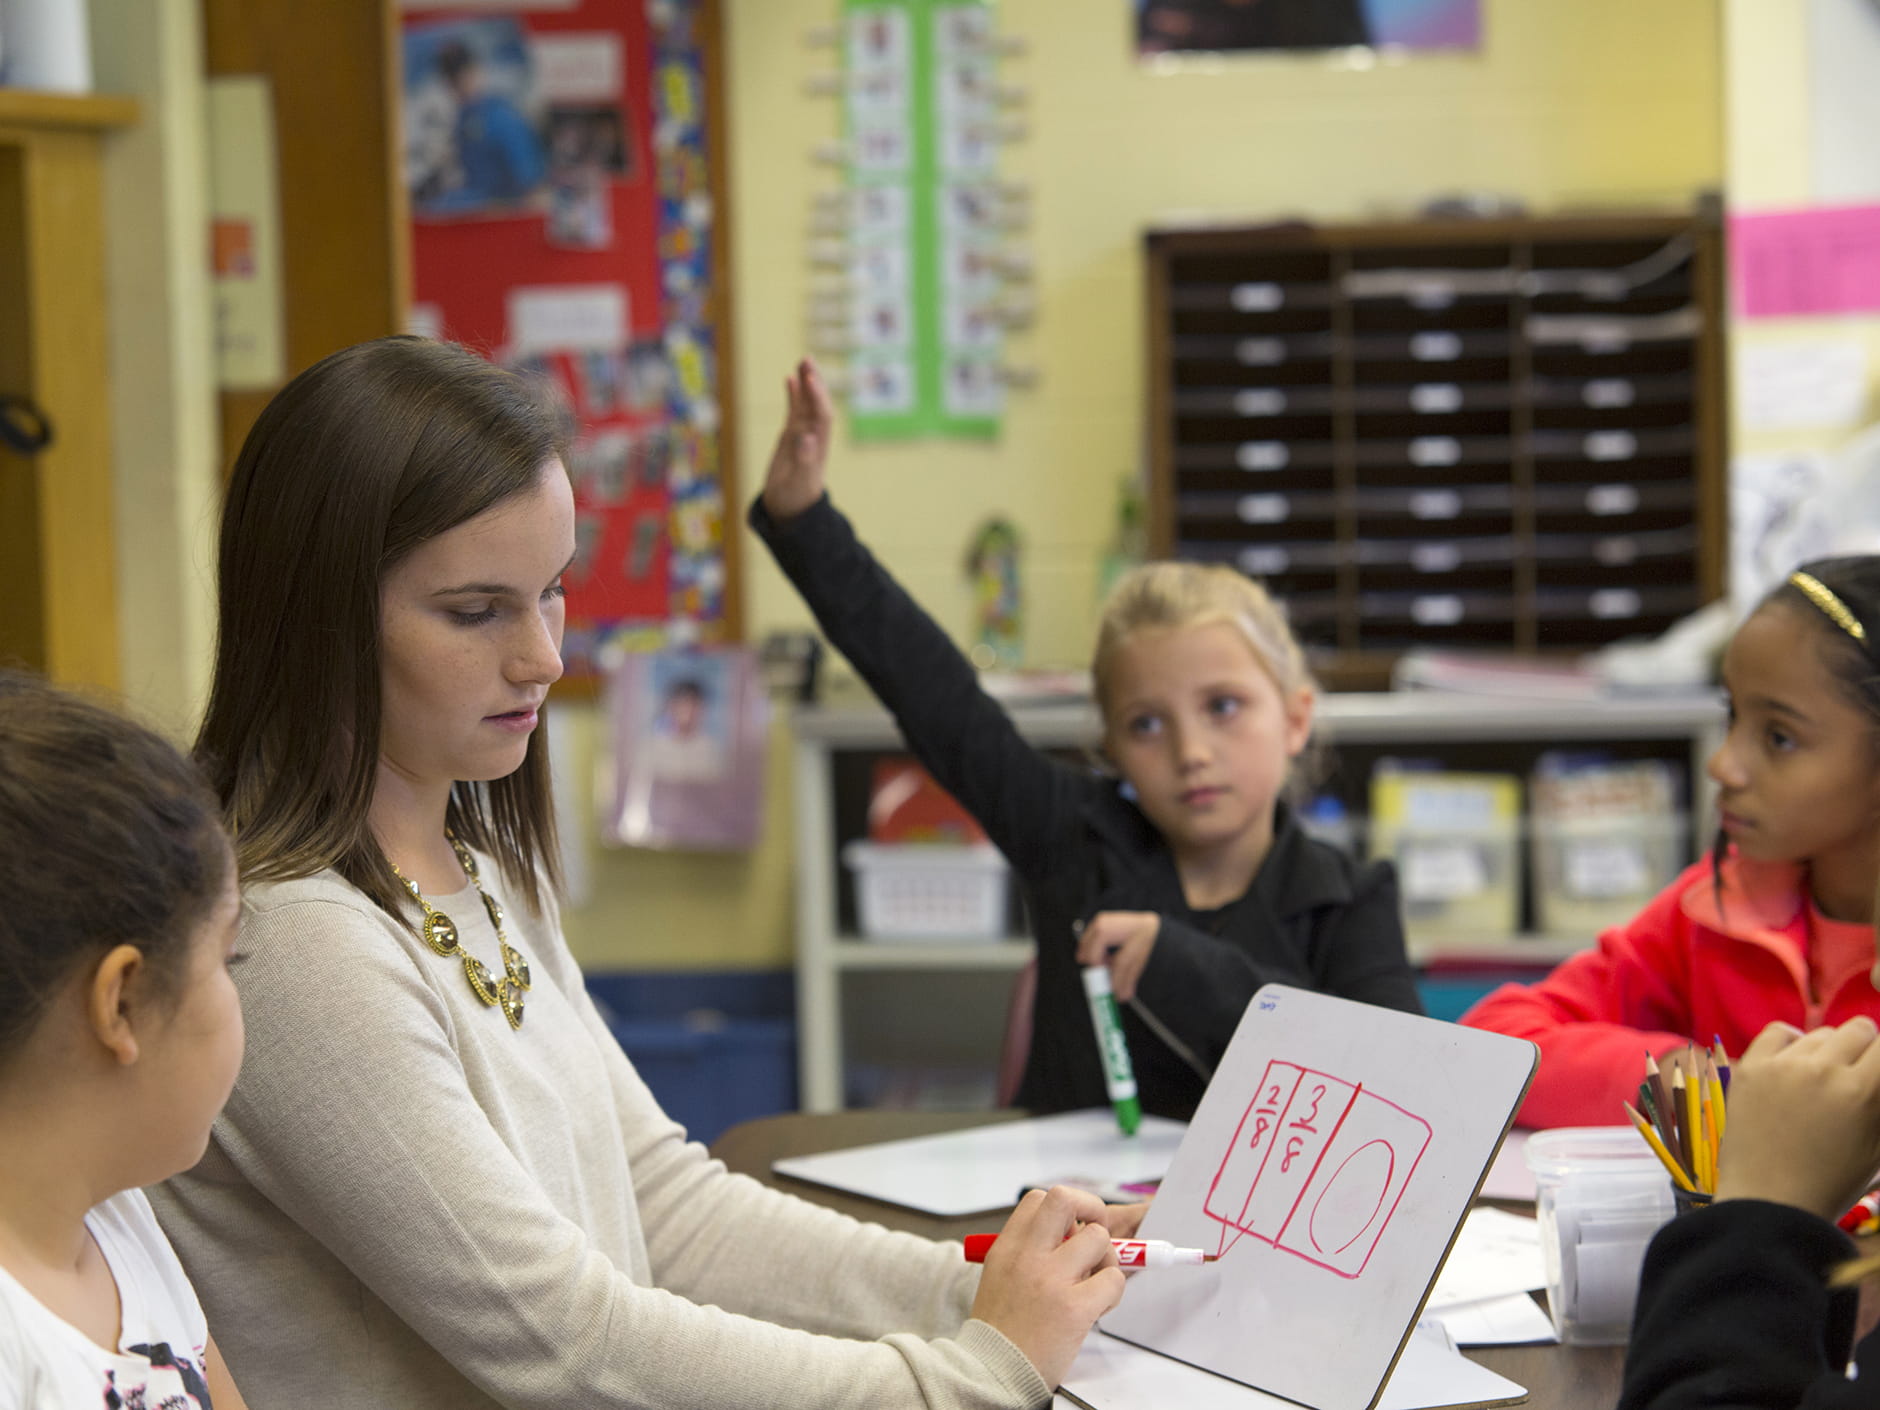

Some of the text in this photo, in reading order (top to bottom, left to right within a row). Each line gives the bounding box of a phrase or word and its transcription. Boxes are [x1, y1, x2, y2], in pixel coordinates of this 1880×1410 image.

[1267, 1085, 1281, 1105] 2
[1299, 1084, 1327, 1124] 3
[1250, 1117, 1269, 1149] 8
[1281, 1136, 1304, 1173] 8
